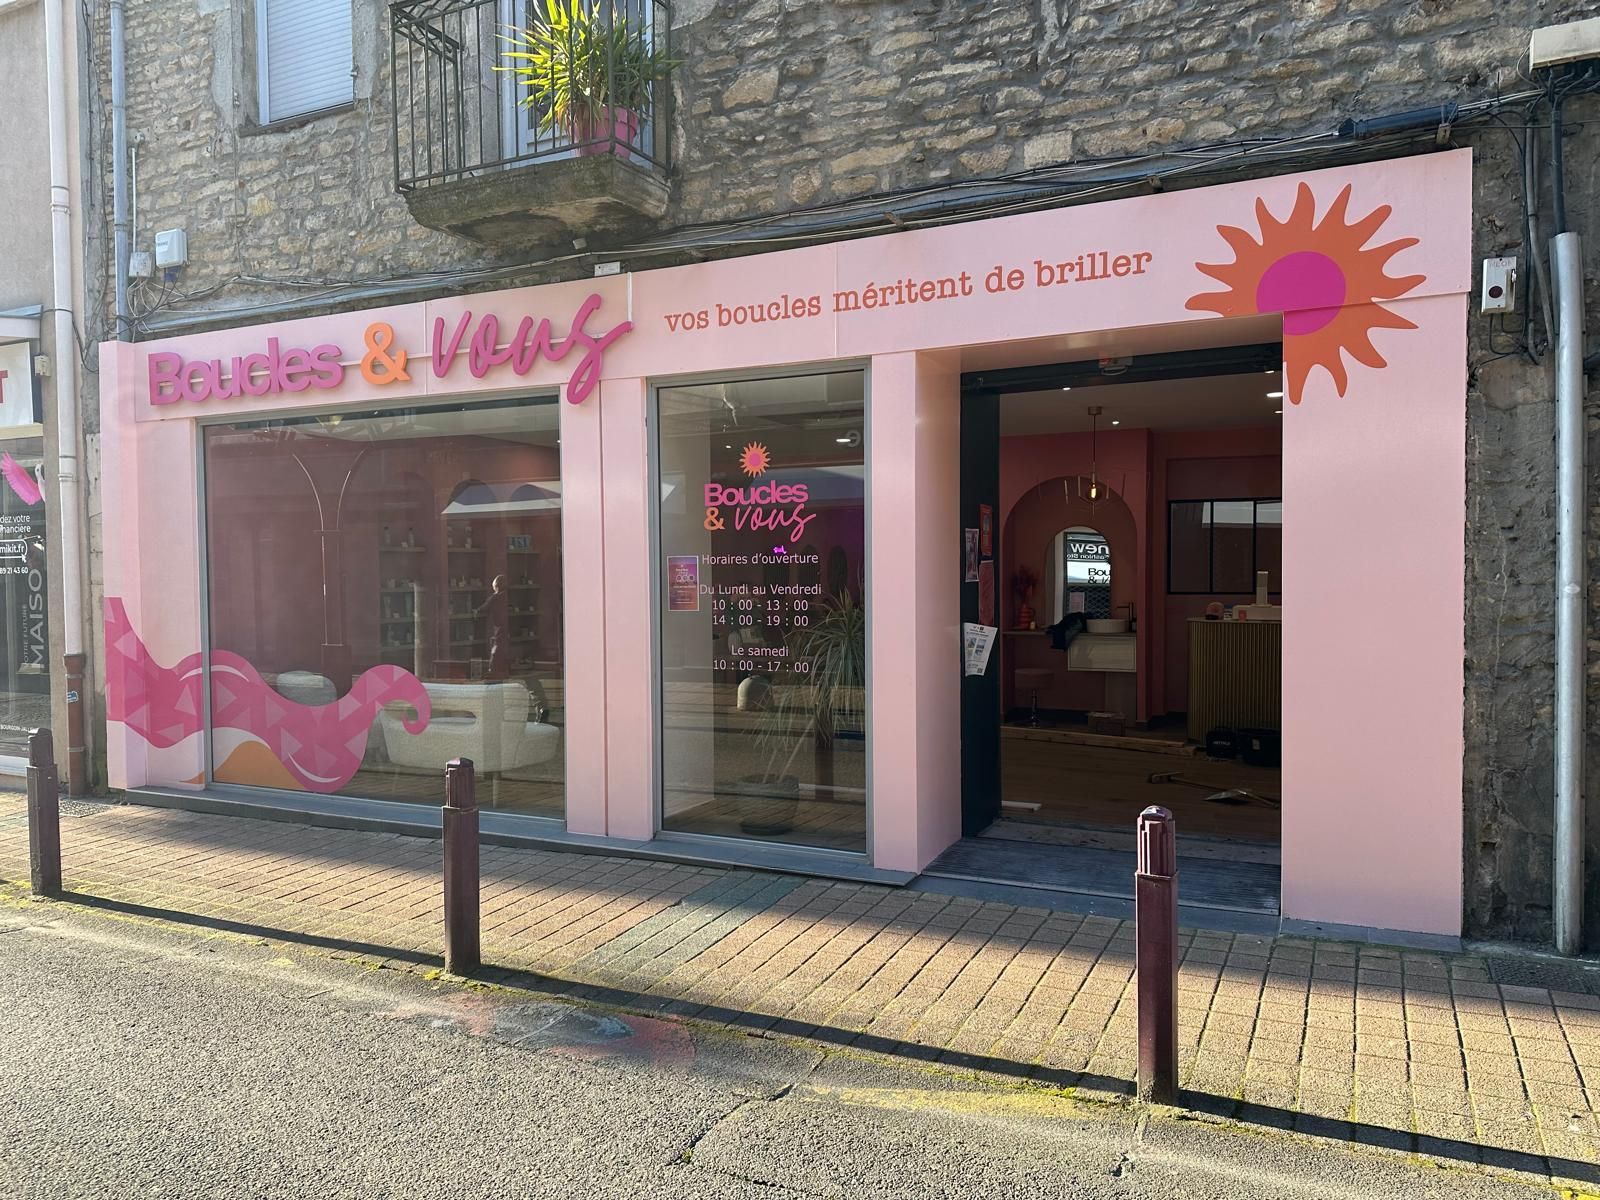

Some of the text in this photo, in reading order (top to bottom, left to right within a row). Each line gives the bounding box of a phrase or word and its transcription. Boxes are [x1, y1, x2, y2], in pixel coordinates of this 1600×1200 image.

[664, 251, 1153, 332] vos boucles méritent de briller
[148, 337, 345, 406] Boucles
[359, 322, 411, 385] &
[703, 479, 809, 507] Boucles
[12, 514, 31, 523] votre
[703, 506, 726, 531] &
[702, 552, 819, 565] Horaires d'ouverture
[7, 566, 13, 575] 21
[13, 566, 20, 574] 43
[20, 566, 29, 574] 60
[699, 583, 822, 595] Du Lundi au Vendredi
[712, 599, 726, 611] 10
[738, 599, 753, 611] 00
[766, 599, 780, 611] 13
[793, 600, 809, 611] 00
[28, 568, 45, 669] MAISO
[712, 614, 726, 625] 14
[738, 614, 753, 626] 00
[766, 615, 781, 626] 19
[793, 615, 809, 627] 00
[731, 644, 789, 657] Le samedi
[713, 659, 727, 670] 10
[739, 660, 754, 671] 00
[767, 661, 781, 672] 17
[794, 661, 809, 673] 00
